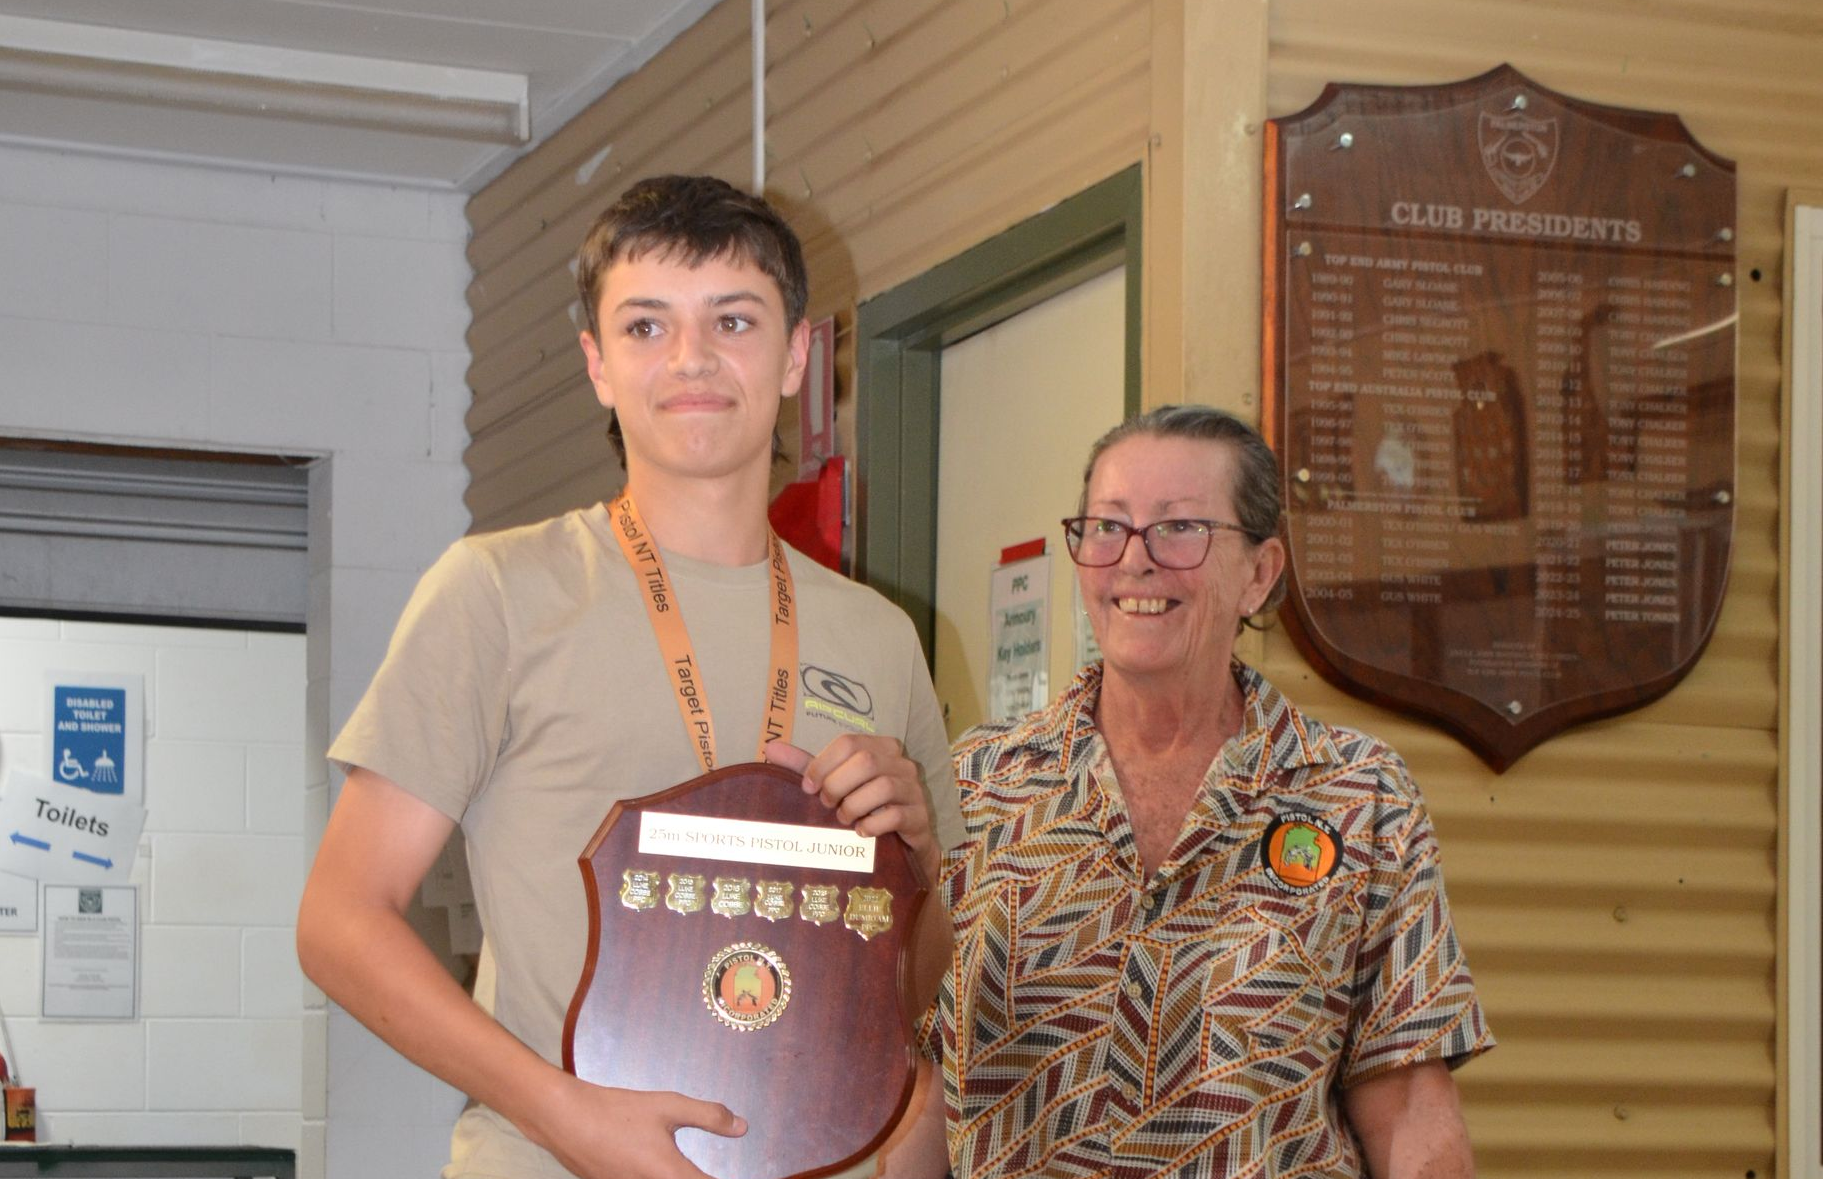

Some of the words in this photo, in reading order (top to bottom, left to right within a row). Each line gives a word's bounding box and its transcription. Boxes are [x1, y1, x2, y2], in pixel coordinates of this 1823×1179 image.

[1391, 202, 1463, 229] CLUB
[1473, 208, 1642, 243] PRESIDENTS
[1325, 254, 1347, 265] TOP
[1350, 256, 1373, 267] END
[1376, 258, 1408, 270] ARMY
[1411, 261, 1450, 273] PISTOL
[1453, 263, 1483, 275] CLUB
[1309, 380, 1332, 391] TOP
[1333, 382, 1358, 393] END
[1360, 384, 1422, 397] AUSTRALIA
[1425, 388, 1463, 400] PISTOL
[1467, 390, 1497, 402] CLUB
[1327, 499, 1401, 513] PALMERSTON
[1405, 503, 1442, 516] PISTOL
[1447, 505, 1476, 517] CLUB
[619, 500, 643, 541] Pistol
[632, 542, 657, 562] NT
[645, 567, 669, 613] Titles
[775, 576, 792, 626] Target
[1306, 587, 1353, 600] 2004-05
[770, 668, 789, 711] Titles
[66, 697, 114, 709] DISABLED
[675, 654, 705, 715] Target
[694, 721, 716, 772] Pisto
[73, 709, 107, 721] TOILET
[58, 721, 79, 732] AND
[81, 722, 122, 734] SHOWER
[34, 798, 110, 838] Toilets
[1281, 812, 1314, 824] PISTOL
[649, 828, 680, 841] 25m
[685, 831, 746, 847] SPORTS
[751, 836, 803, 853] PISTOL
[806, 842, 866, 859] JUNIOR
[1265, 867, 1330, 895] INCORPORATED
[724, 954, 754, 969] PISTOL
